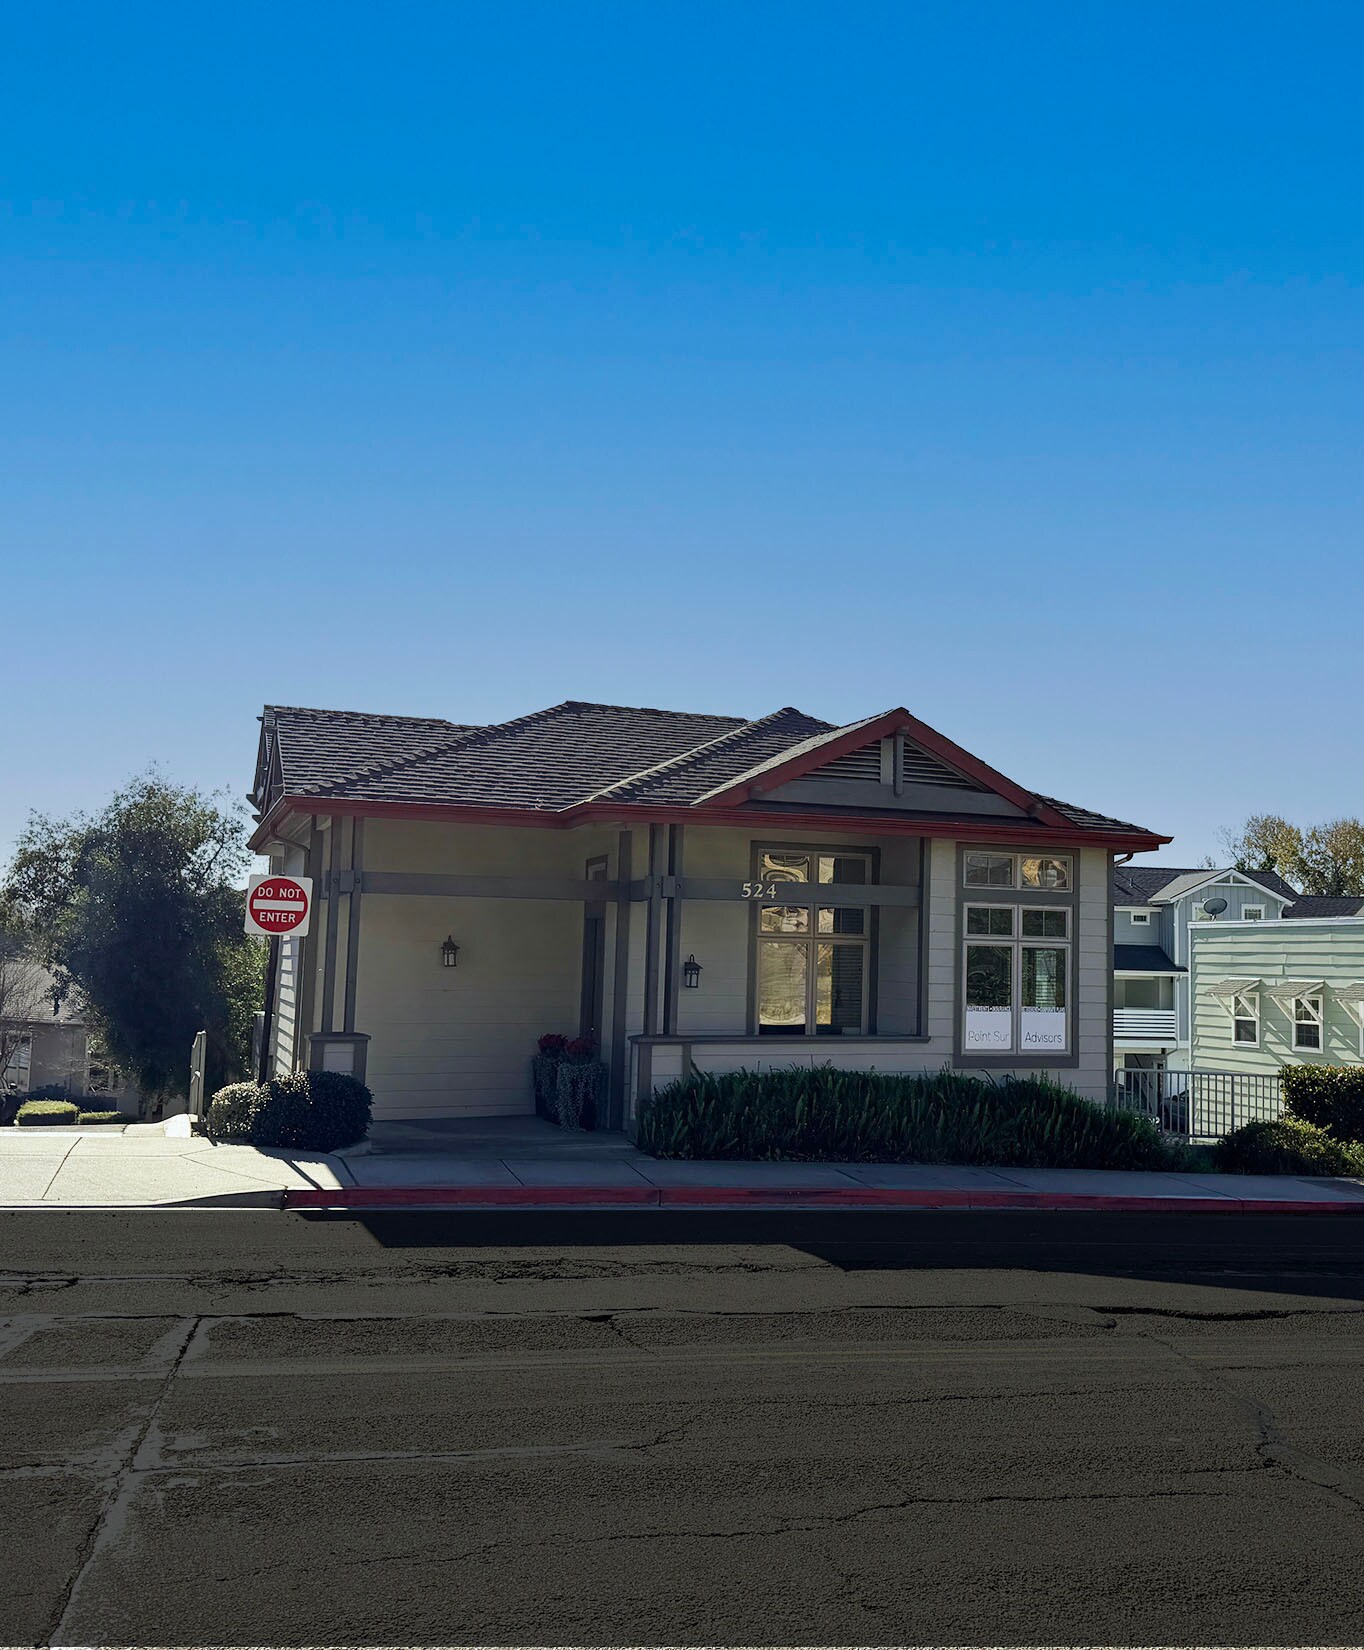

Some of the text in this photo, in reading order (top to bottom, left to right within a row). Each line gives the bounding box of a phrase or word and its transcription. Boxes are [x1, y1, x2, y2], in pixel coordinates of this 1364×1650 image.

[257, 887, 302, 899] DO NOT
[741, 882, 777, 899] 524
[259, 911, 296, 923] ENTER
[968, 1030, 1063, 1043] Point Sur Advisors
